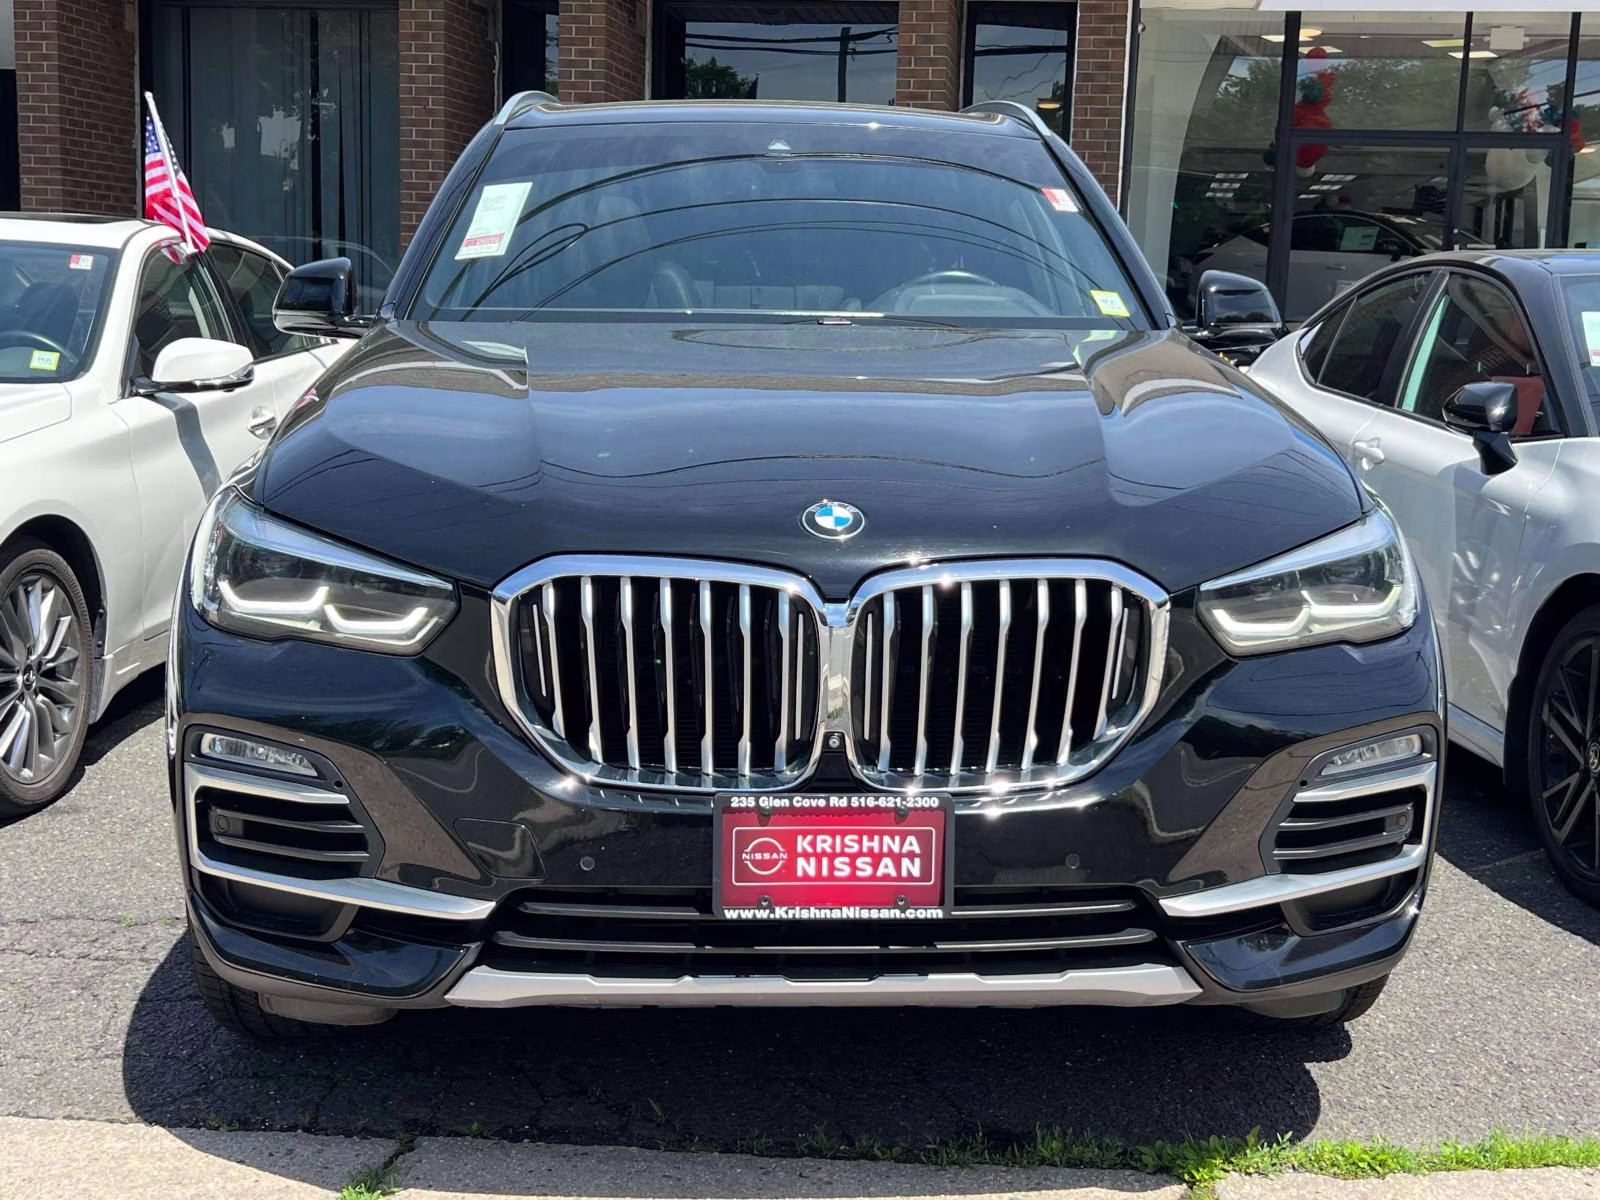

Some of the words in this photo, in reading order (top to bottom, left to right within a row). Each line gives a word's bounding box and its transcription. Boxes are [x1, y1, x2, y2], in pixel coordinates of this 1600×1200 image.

[730, 796, 756, 808] 235
[759, 796, 790, 808] Glen
[792, 796, 827, 808] Cove
[829, 796, 848, 808] Rd
[850, 796, 940, 808] 516-621-2300
[796, 834, 921, 854] KRISHNA
[742, 852, 788, 860] NISSAN
[796, 856, 921, 878] NISSAN
[723, 906, 944, 919] www.KrishnaNissan.com
